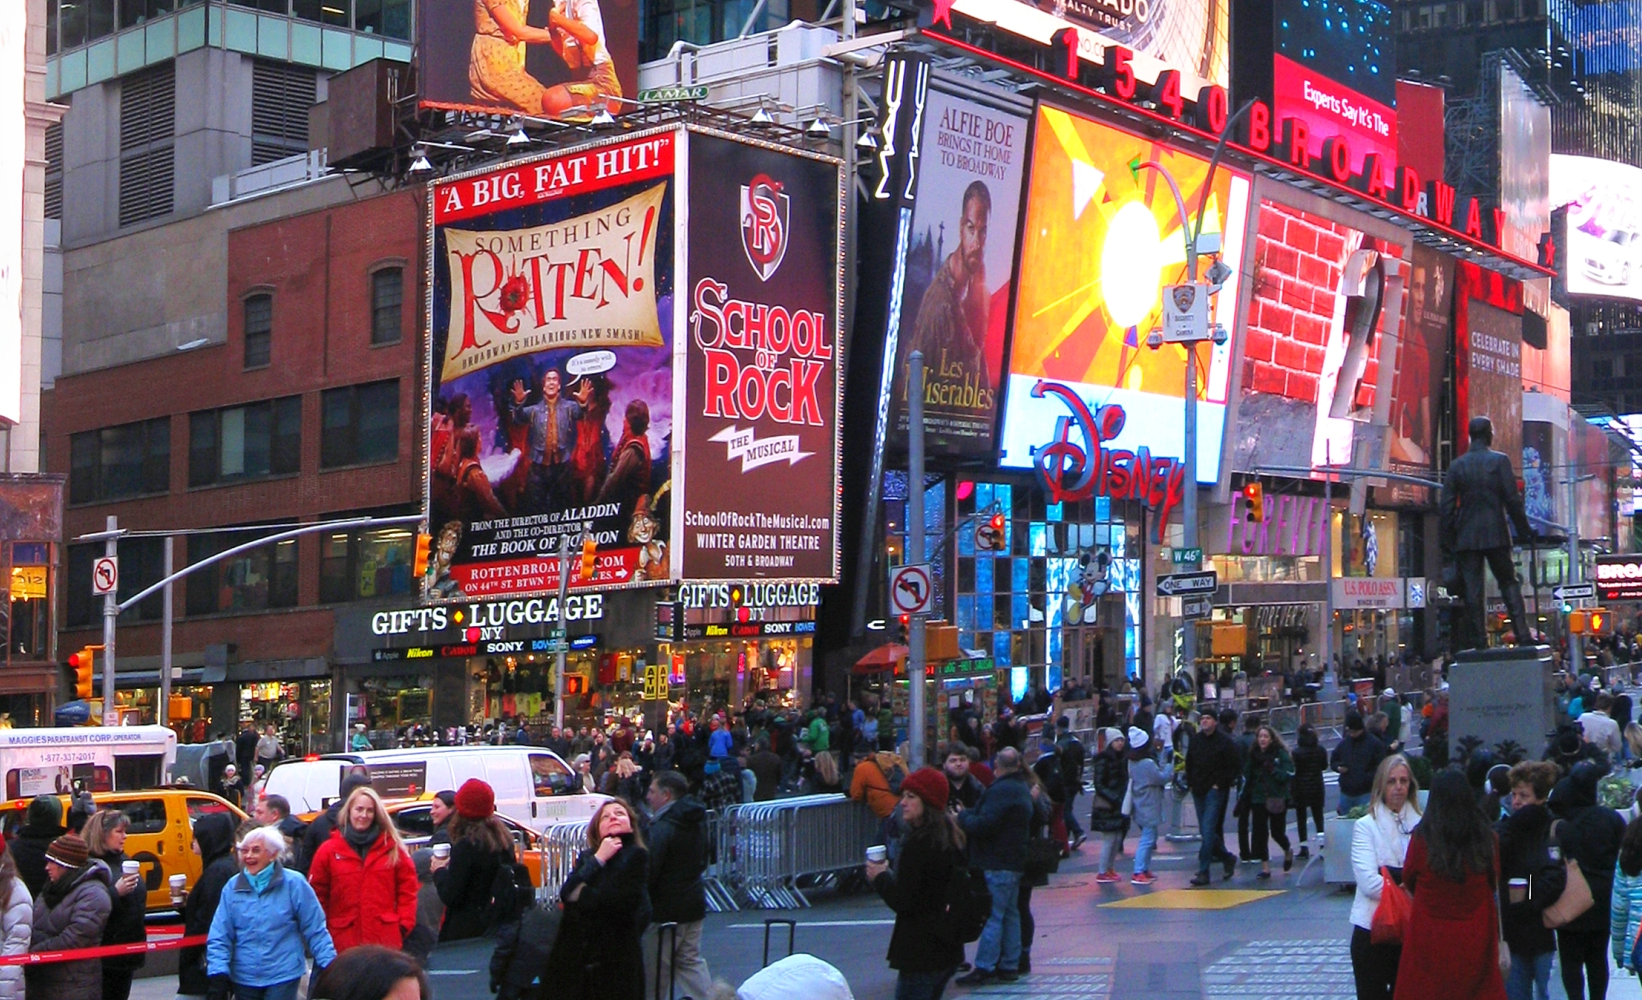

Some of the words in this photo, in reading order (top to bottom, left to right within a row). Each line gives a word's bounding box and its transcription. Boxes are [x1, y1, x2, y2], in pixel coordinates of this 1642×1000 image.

[1098, 10, 1133, 33] TRUST
[644, 87, 702, 101] LAMAR
[1304, 80, 1340, 113] Experts
[1342, 98, 1358, 126] Say
[1359, 106, 1372, 128] It's
[1373, 113, 1389, 136] The
[939, 106, 982, 139] ALFIE
[985, 119, 1014, 147] BOE
[938, 131, 972, 154] BRINGS
[973, 141, 981, 156] IT
[984, 144, 1013, 165] HOME
[941, 150, 955, 167] TO
[957, 154, 1006, 180] BROADWAY
[1249, 102, 1506, 250] BROADWAY
[472, 172, 525, 206] BIG,
[534, 157, 586, 192] FAT
[475, 206, 631, 255] SOMETHING
[690, 277, 832, 361] SCHOOL
[462, 340, 520, 370] BROADWAY'S
[523, 329, 577, 348] HILARIOUS
[581, 328, 602, 340] NEW
[607, 327, 644, 341] SMASH!
[1472, 332, 1510, 357] CELEBRATE
[1511, 343, 1519, 358] IN
[755, 350, 776, 370] OF
[939, 348, 964, 378] Les
[1472, 353, 1494, 372] EVERY
[1496, 359, 1519, 377] SHADE
[703, 347, 824, 426] ROCK
[731, 434, 749, 450] THE
[746, 440, 794, 463] MUSICAL
[685, 510, 829, 530] SchoolOfRockTheMusical.com
[696, 533, 735, 550] WINTER
[738, 533, 776, 550] GARDEN
[780, 533, 819, 551] THEATRE
[725, 554, 745, 567] 50TH
[747, 555, 753, 566] &
[755, 555, 794, 568] BROADWAY
[1174, 551, 1182, 561] W
[678, 584, 730, 608] GIFTS
[743, 583, 820, 606] LUGGAGE
[1164, 581, 1182, 590] ONE
[1192, 578, 1211, 588] WAY
[1344, 581, 1357, 595] U.S.
[1359, 581, 1377, 595] POLO
[1378, 580, 1397, 596] ASSN.
[372, 606, 447, 635] GIFTS
[469, 594, 602, 628] LUGGAGE
[705, 625, 729, 636] Nikon
[731, 625, 760, 636] Canon
[764, 623, 792, 634] SONY
[794, 622, 816, 632] BOWER
[647, 667, 656, 695] ATM
[9, 736, 46, 744] MAGGIES
[48, 734, 88, 744] PARATRANSIT
[89, 733, 111, 743] CORP.
[113, 733, 142, 742] OPERATOR
[40, 752, 96, 762] 1-877-337-2017
